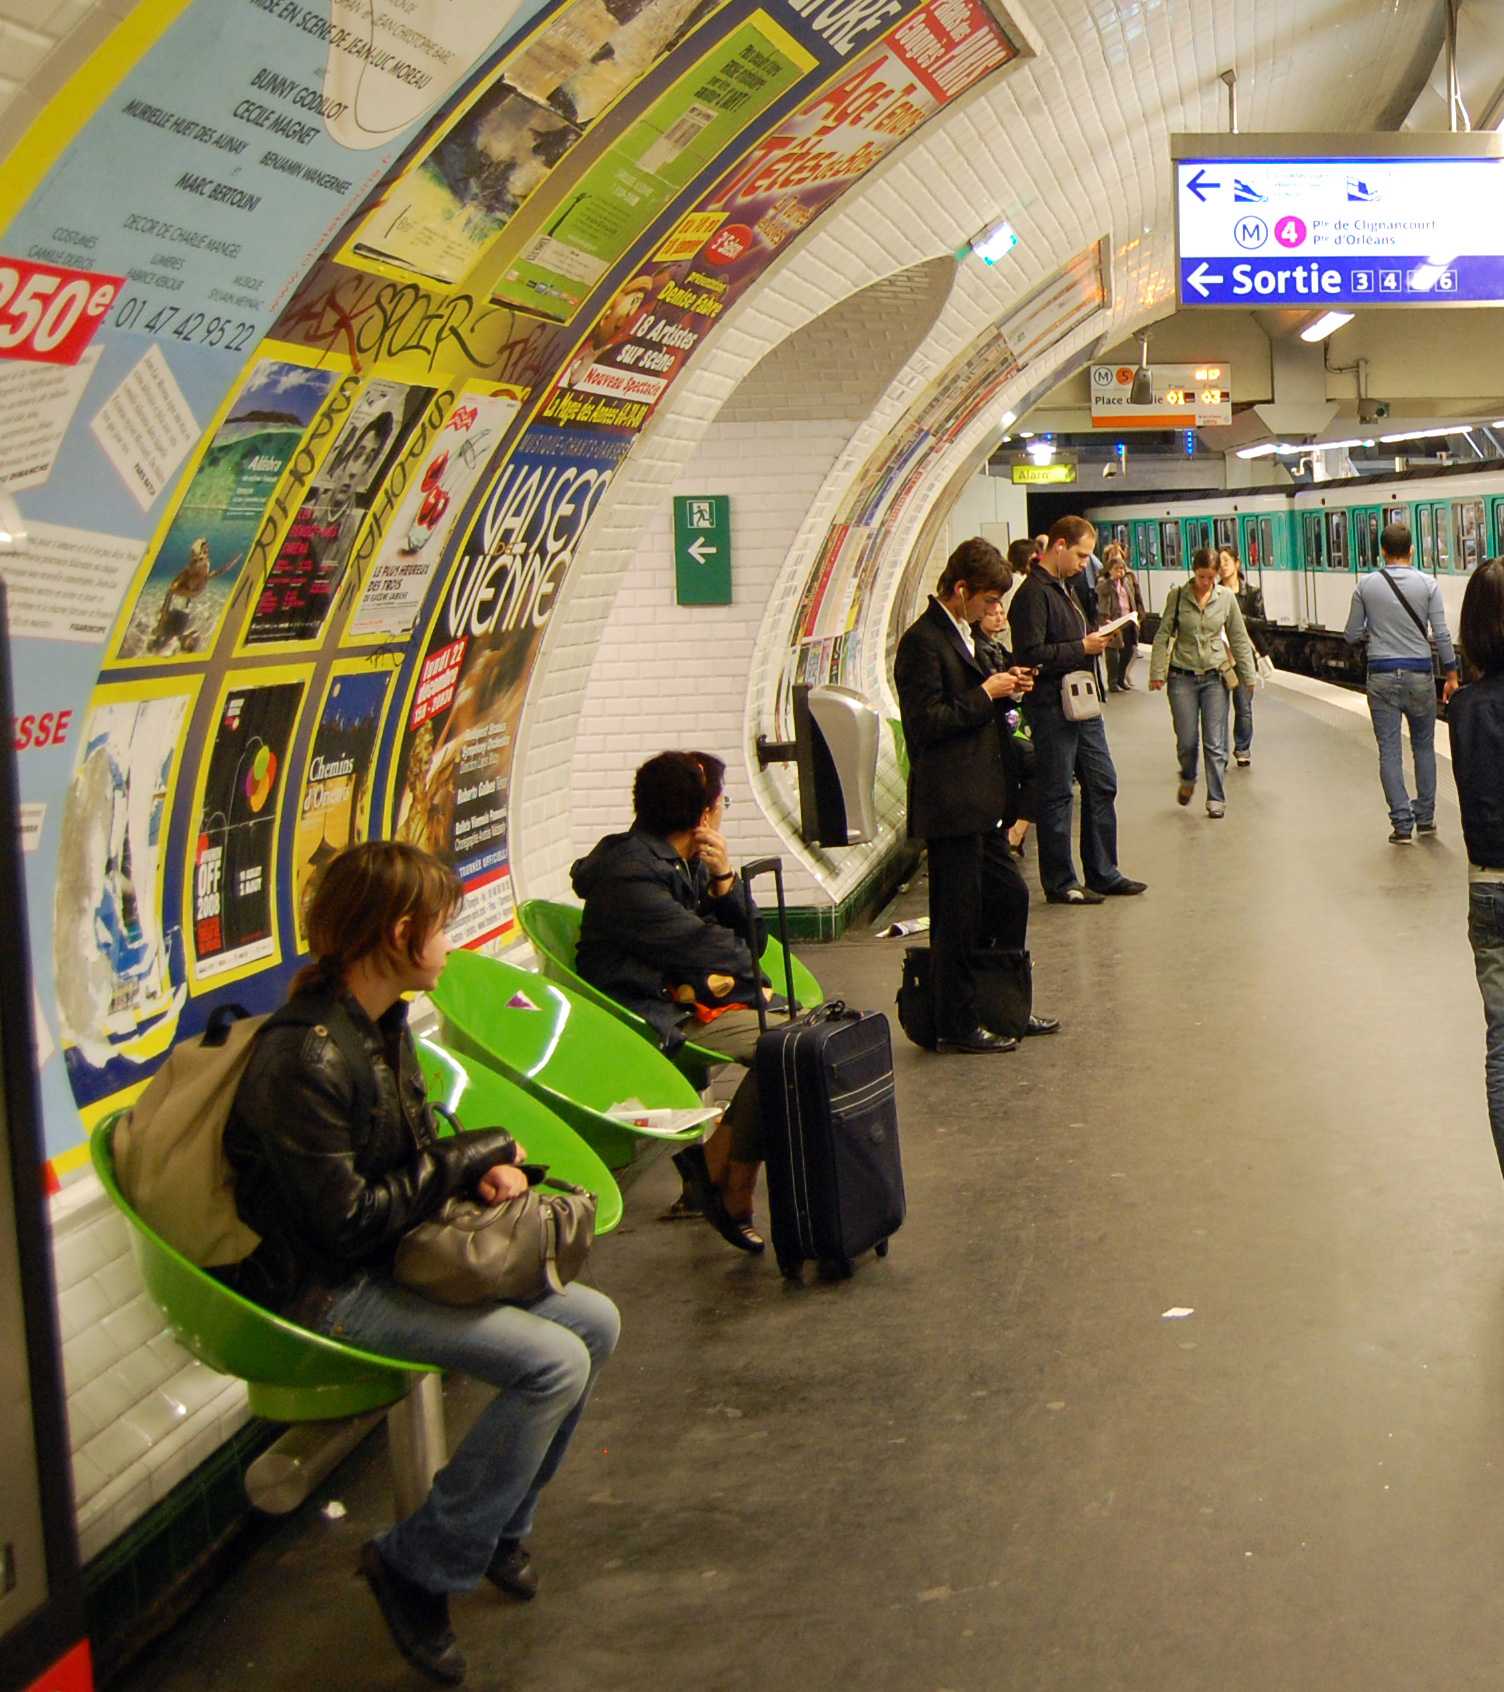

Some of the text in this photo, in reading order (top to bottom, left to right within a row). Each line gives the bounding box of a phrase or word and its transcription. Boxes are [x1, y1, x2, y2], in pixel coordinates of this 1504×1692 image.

[298, 11, 336, 44] SCENE
[393, 60, 433, 90] MOREAU
[251, 68, 297, 98] BUNNY
[233, 100, 320, 145] CECILE MAGNET
[175, 173, 208, 197] MARC
[1334, 220, 1349, 231] de
[1232, 262, 1341, 296] Sortie
[115, 297, 256, 352] 01 47 42 95 22
[629, 313, 699, 350] 18 Artistes
[616, 343, 676, 373] sur scène
[585, 368, 623, 390] Nouveau
[1095, 396, 1123, 405] Place
[449, 552, 571, 638] VIENNE
[9, 710, 72, 751] SSE
[310, 752, 355, 782] Chemins
[198, 860, 222, 897] OFF
